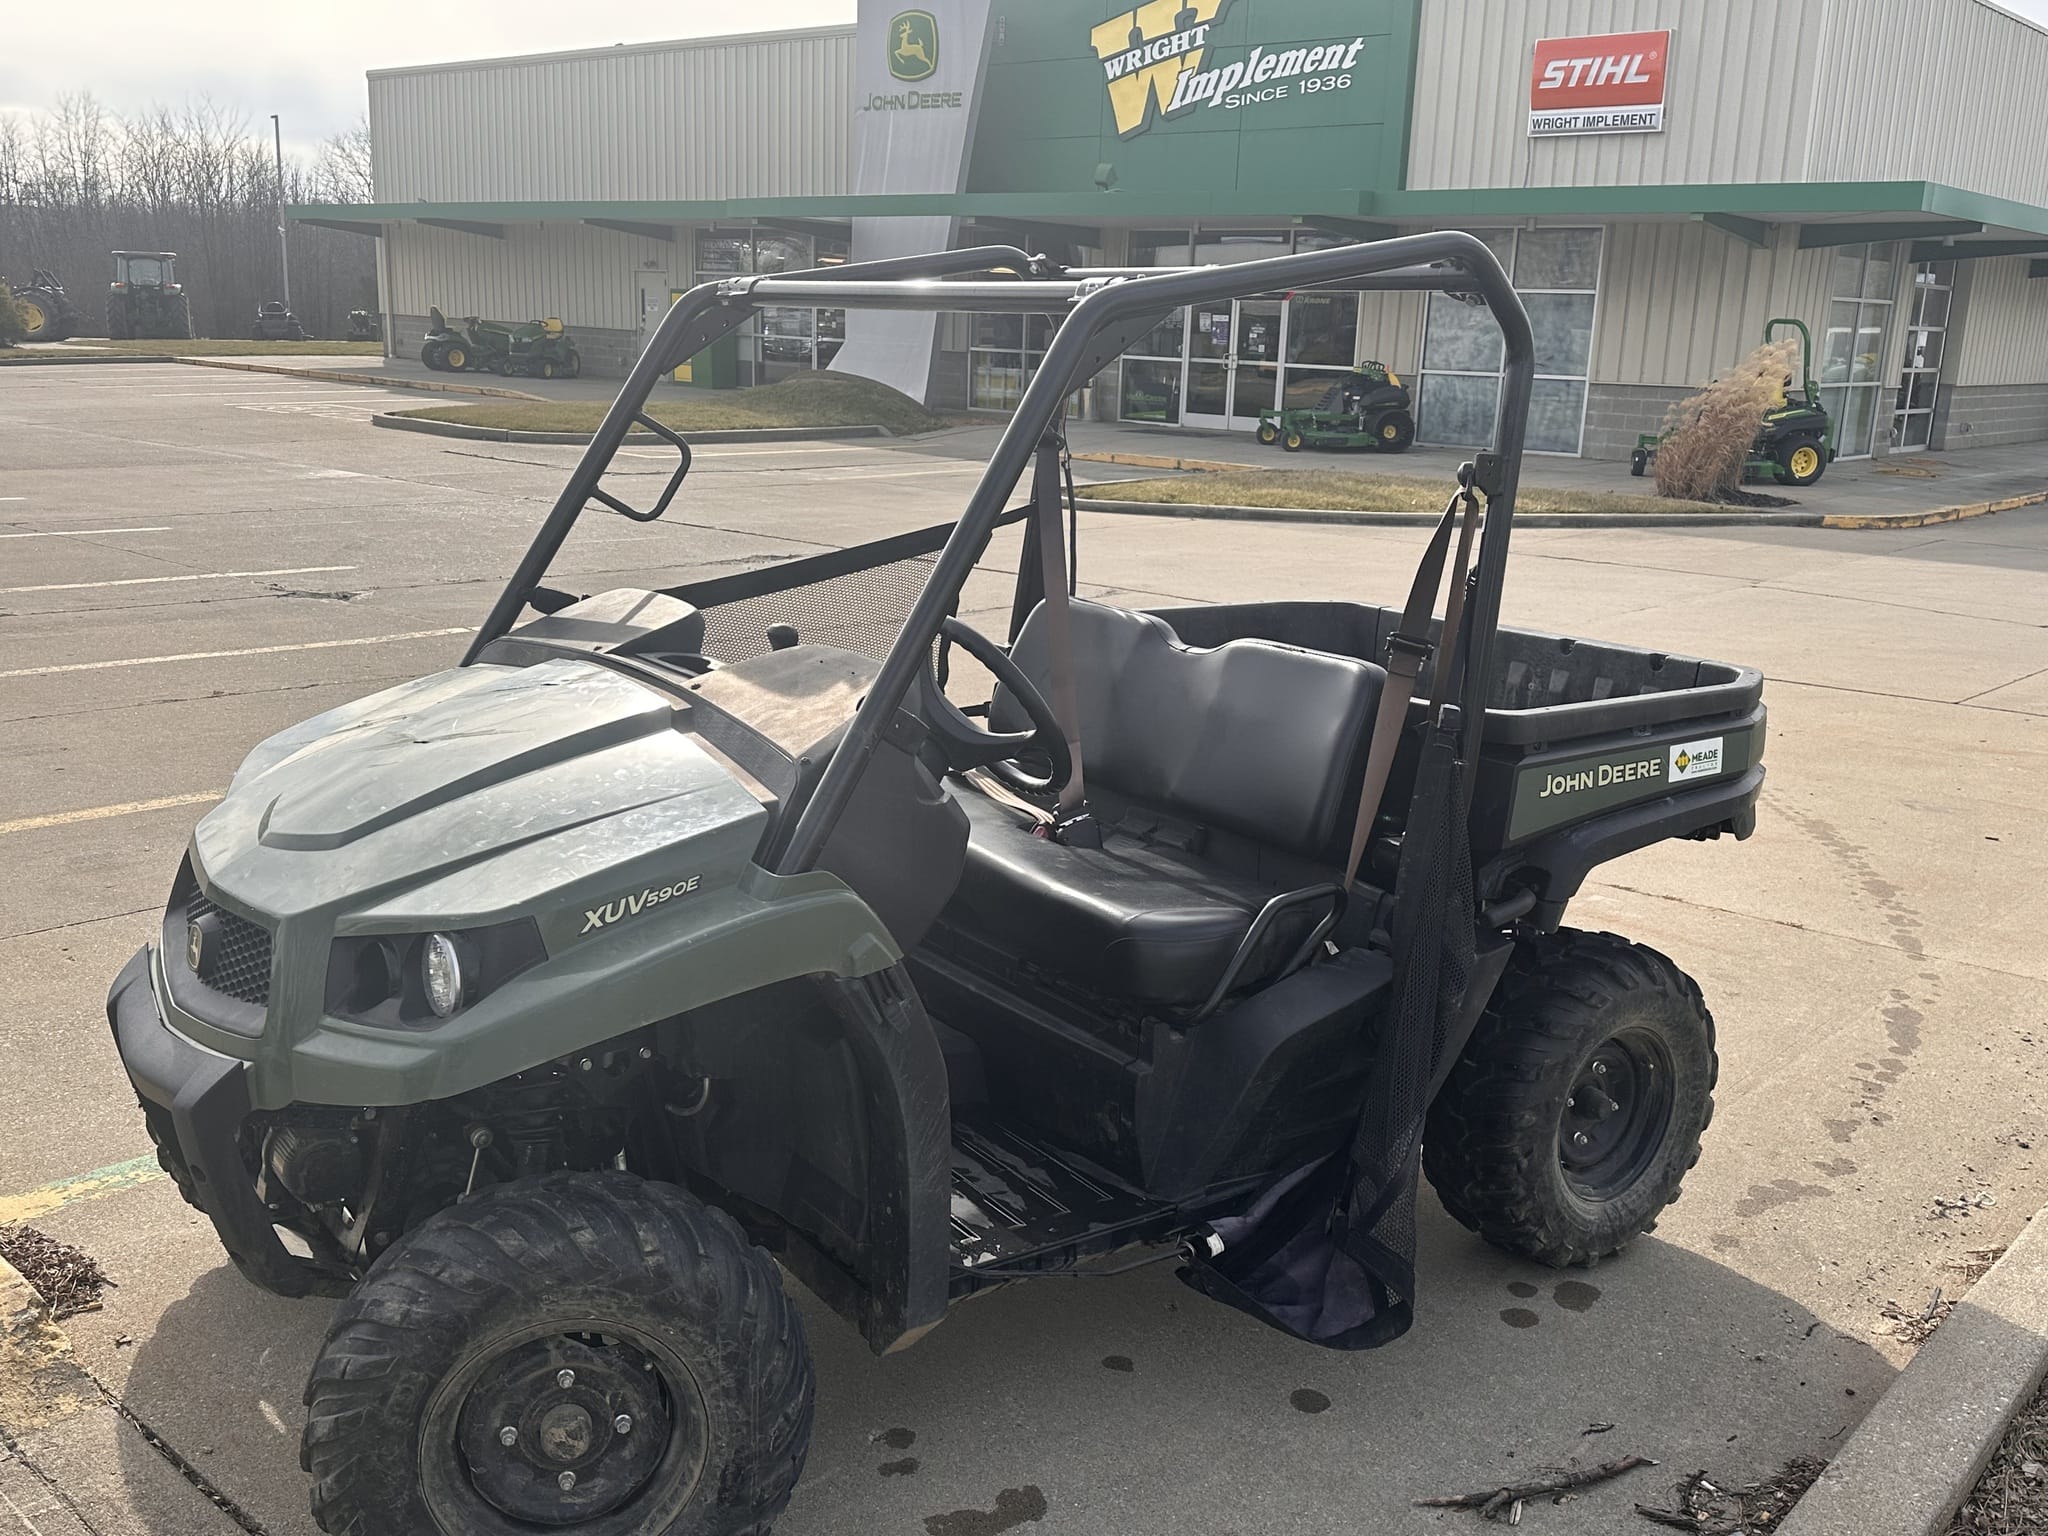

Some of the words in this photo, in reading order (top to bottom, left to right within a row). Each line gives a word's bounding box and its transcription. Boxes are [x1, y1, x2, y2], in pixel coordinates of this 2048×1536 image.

[1104, 24, 1210, 80] WRIGHT
[1167, 37, 1365, 113] Implement
[1538, 54, 1650, 89] STIHL
[863, 92, 906, 112] JOHN
[907, 90, 963, 109] DEERE
[1224, 86, 1289, 109] SINCE
[1298, 74, 1352, 95] 1936
[1532, 116, 1580, 130] WRIGHT
[1582, 113, 1656, 128] IMPLEMENT
[1691, 748, 1719, 762] MEADE
[1539, 770, 1594, 798] JOHN
[1598, 758, 1662, 787] DEERE
